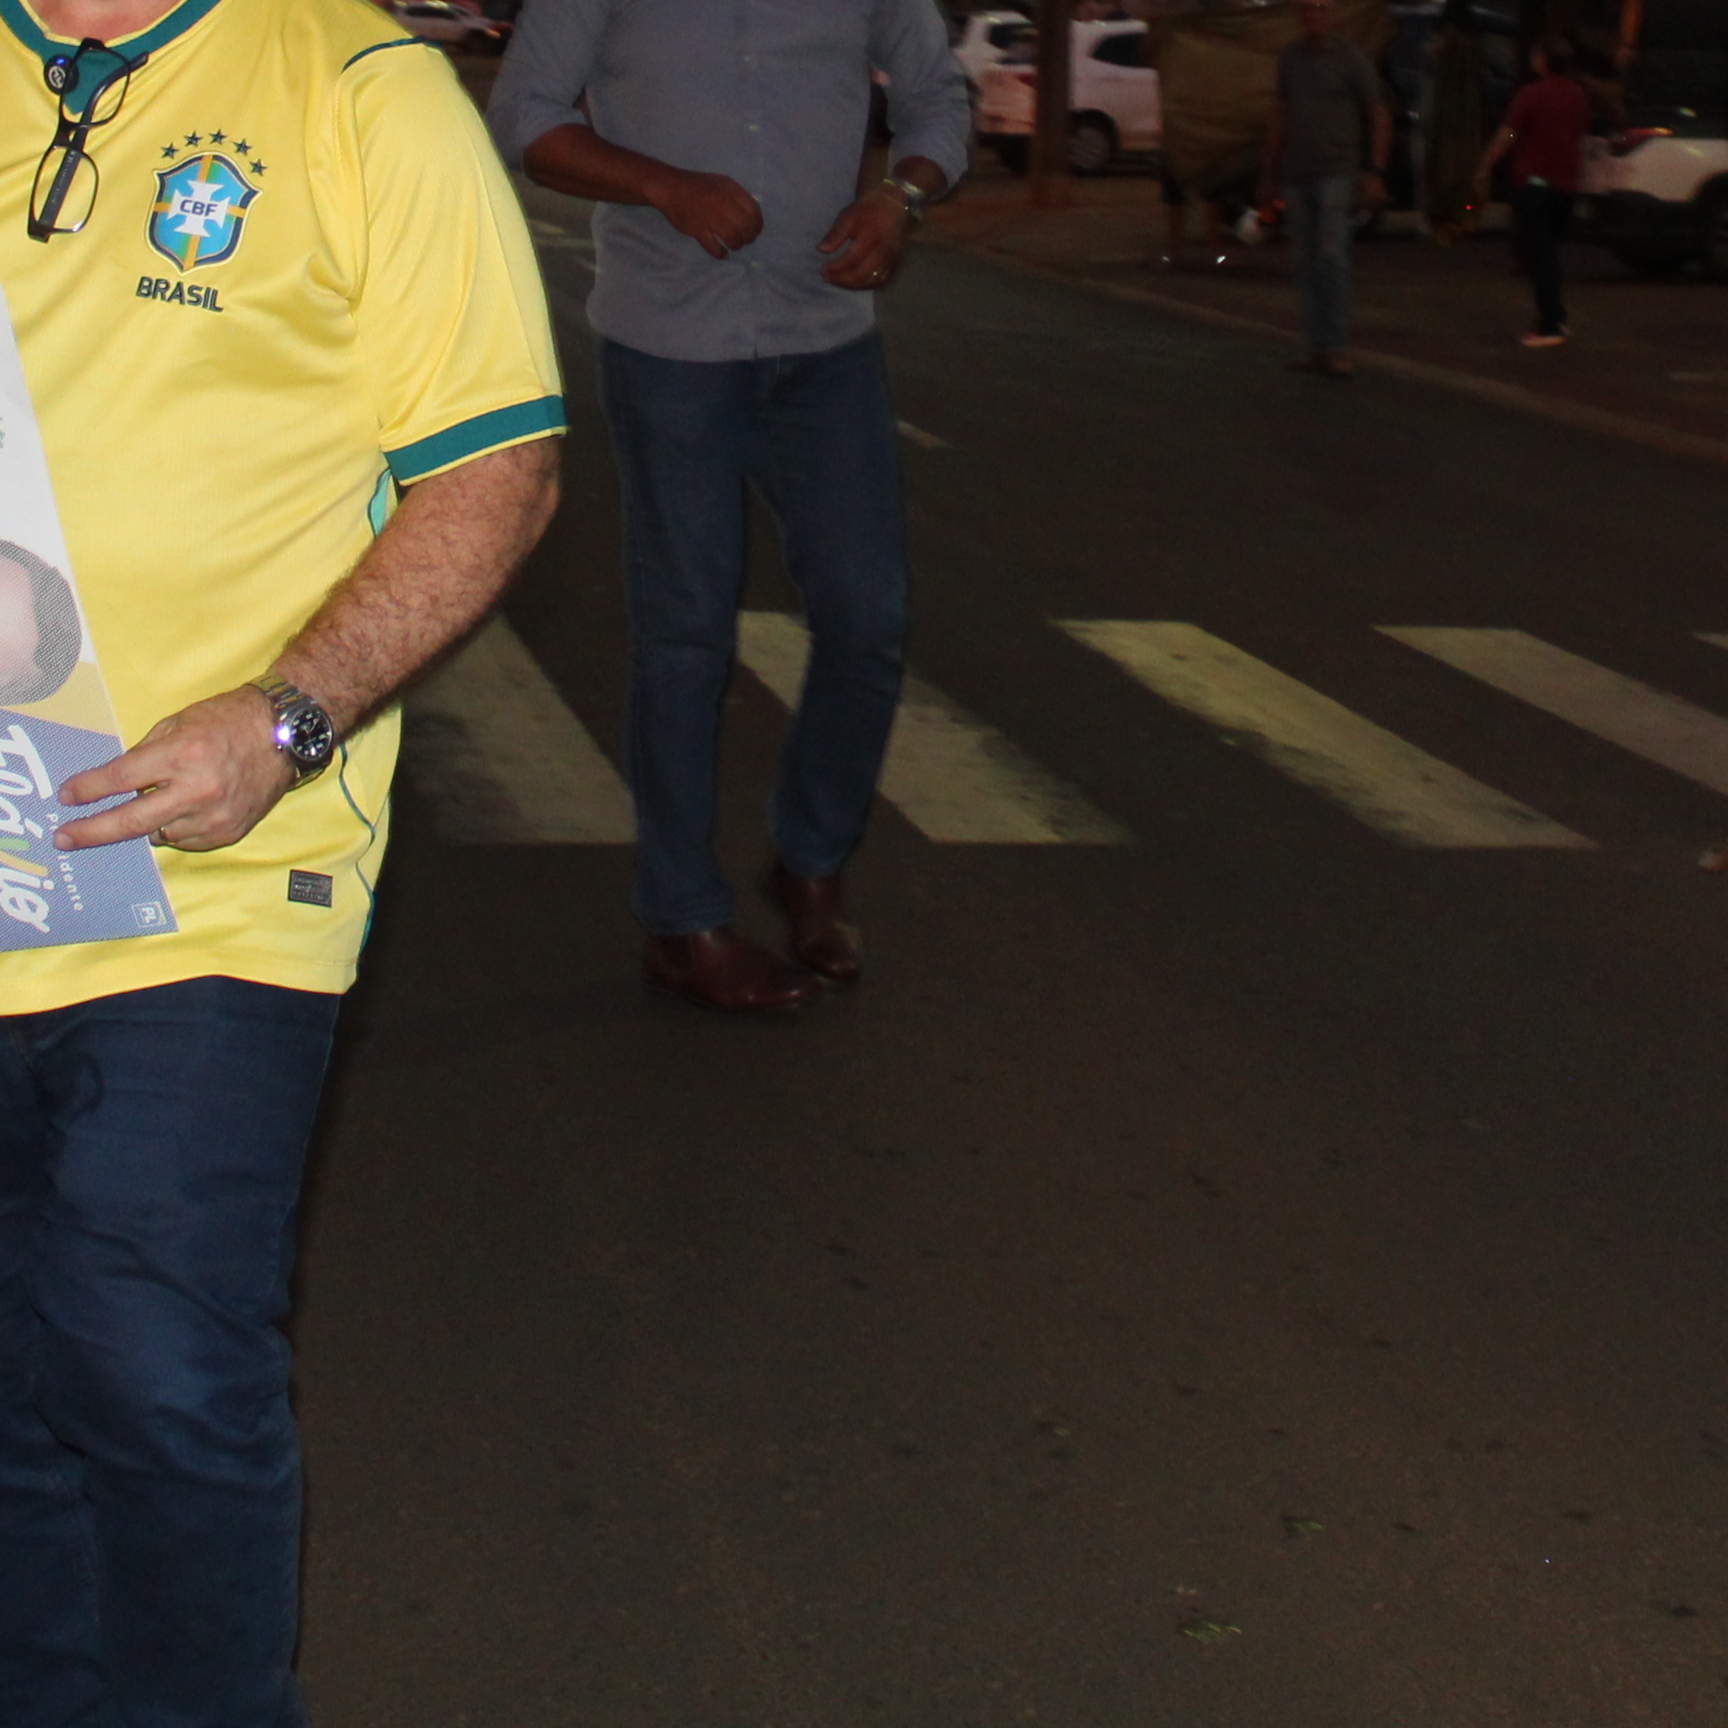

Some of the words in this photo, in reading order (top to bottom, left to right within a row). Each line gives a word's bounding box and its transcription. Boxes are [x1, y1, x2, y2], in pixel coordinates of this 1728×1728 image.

[180, 199, 219, 217] CBF
[136, 275, 224, 313] BRASIL
[45, 812, 84, 912] Pridente
[140, 906, 159, 925] PL
